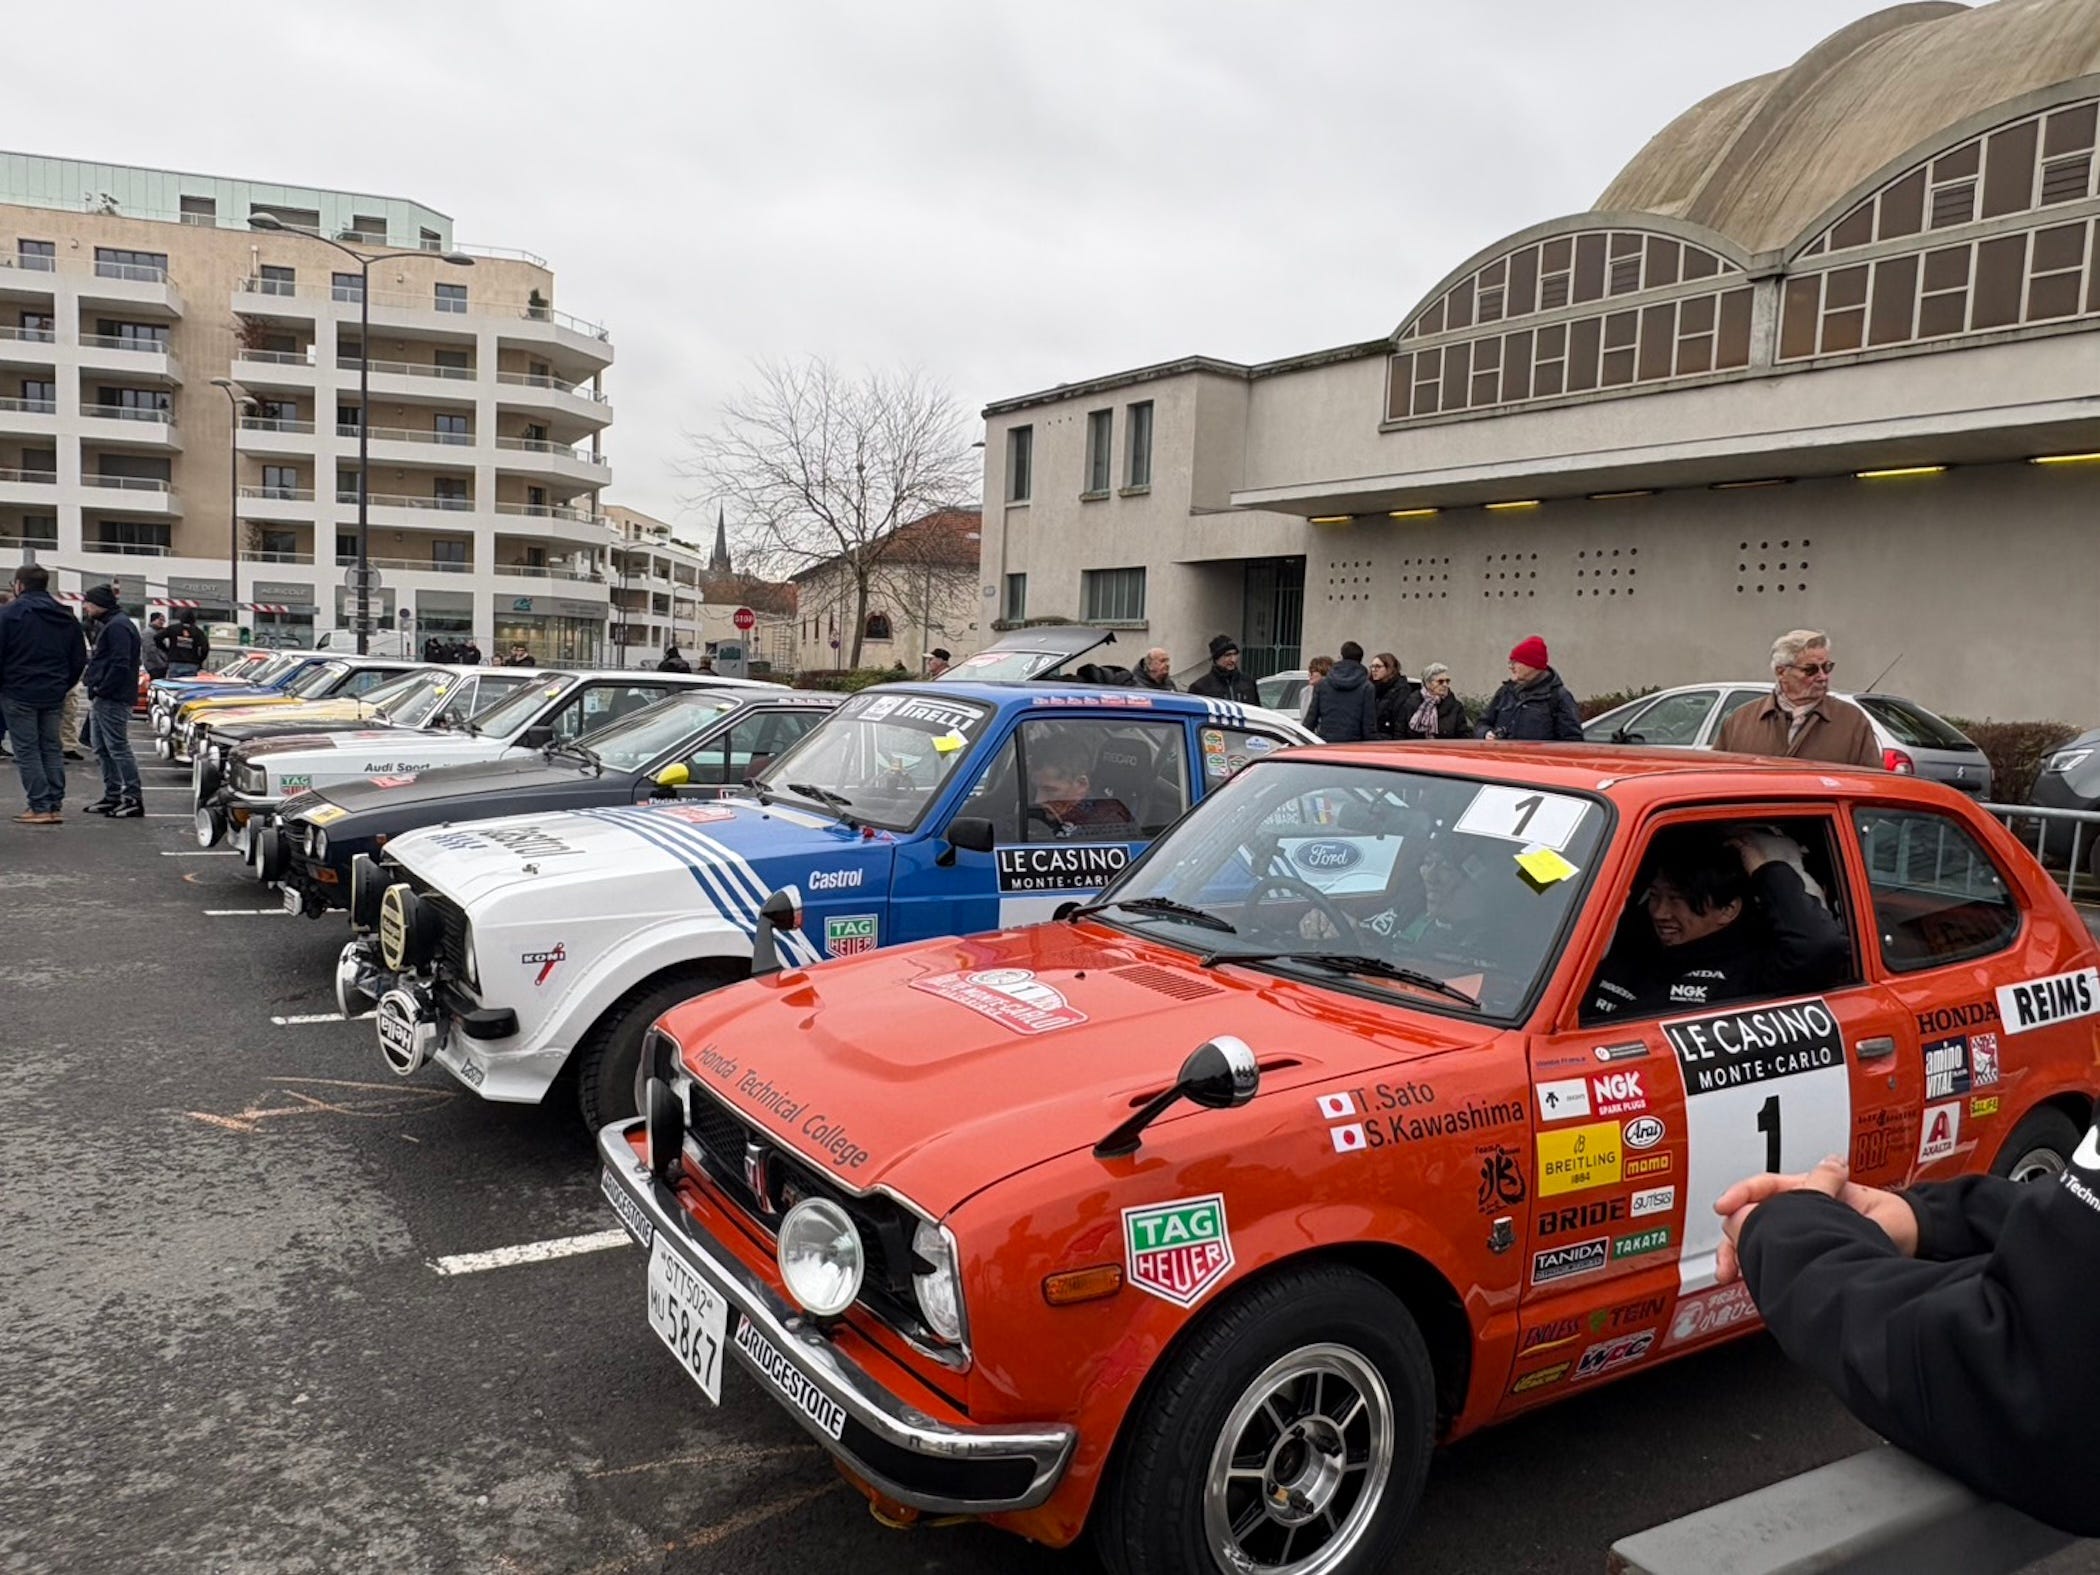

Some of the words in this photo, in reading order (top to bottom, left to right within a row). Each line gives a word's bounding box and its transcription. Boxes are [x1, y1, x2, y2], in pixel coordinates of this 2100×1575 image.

[735, 614, 753, 624] STOP
[894, 697, 985, 732] PIRELLI
[285, 776, 309, 785] TAG
[364, 762, 394, 773] Audi
[396, 762, 431, 773] Sport
[1511, 795, 1545, 837] 1
[1001, 851, 1028, 873] LE
[1031, 848, 1126, 873] CASINO
[1308, 844, 1349, 866] Ford
[808, 867, 863, 890] Castrol
[831, 920, 871, 936] TAG
[523, 951, 565, 963] KONI
[1669, 984, 1708, 998] NGK
[2013, 973, 2092, 1027] REIMS
[381, 1014, 413, 1051] Hella
[1671, 1023, 1715, 1062] LE
[1712, 1004, 1832, 1055] CASINO
[1916, 1001, 2001, 1035] HONDA
[1925, 1040, 1963, 1076] amino
[1349, 1081, 1435, 1113] T.Sato
[1592, 1070, 1645, 1104] NGK
[1925, 1070, 1955, 1100] VITAL
[694, 1042, 738, 1079] Honda
[735, 1068, 810, 1124] Technical
[801, 1115, 869, 1169] College
[1598, 1101, 1622, 1116] SPARK
[1622, 1098, 1647, 1112] PLUGS
[1364, 1100, 1525, 1149] S.Kawashima
[1629, 1119, 1658, 1140] Arai
[1757, 1094, 1782, 1174] 1
[1545, 1151, 1616, 1176] BREITLING
[1571, 1172, 1591, 1184] 1884
[1626, 1155, 1669, 1176] momo
[602, 1168, 651, 1244] BRIDGESTONE
[1538, 1196, 1627, 1237] BRIDE
[1136, 1208, 1214, 1246] TAG
[1615, 1230, 1668, 1255] TAKATA
[1138, 1242, 1221, 1293] HEUER
[1537, 1243, 1604, 1269] TANIDA
[1609, 1295, 1666, 1328] TEIN
[668, 1293, 718, 1388] 5867
[737, 1316, 844, 1437] BRIDGESTONE
